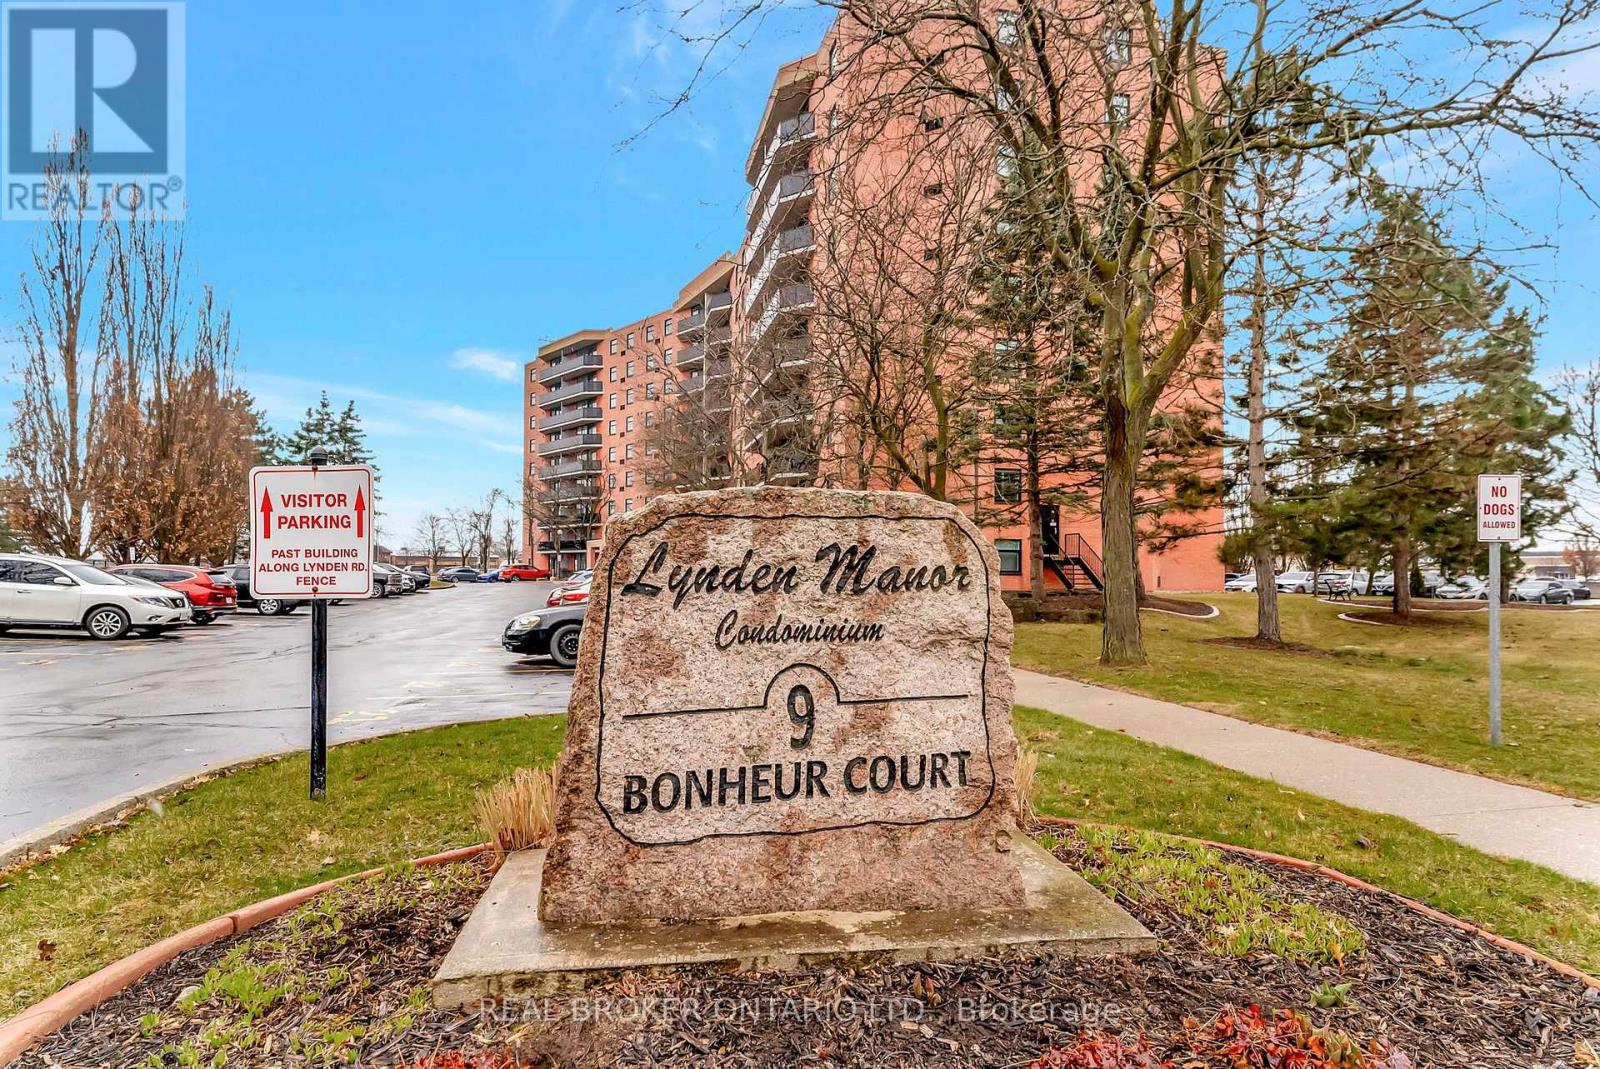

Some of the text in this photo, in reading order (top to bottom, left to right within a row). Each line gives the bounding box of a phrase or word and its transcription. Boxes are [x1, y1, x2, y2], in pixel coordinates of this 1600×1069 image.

[1491, 486, 1507, 497] NO
[281, 494, 347, 508] VISITOR
[1484, 504, 1515, 515] DOGS
[278, 515, 351, 529] PARKING
[1483, 521, 1516, 529] ALLOWED
[272, 549, 358, 558] PAST BUILDING
[259, 563, 367, 572] ALONG LYNDEN RD.
[296, 576, 336, 585] FENCE
[621, 542, 971, 610] Lynden Manor
[714, 610, 885, 651] Condominium
[786, 684, 816, 749] 9
[623, 750, 971, 815] BONHEUR COURT
